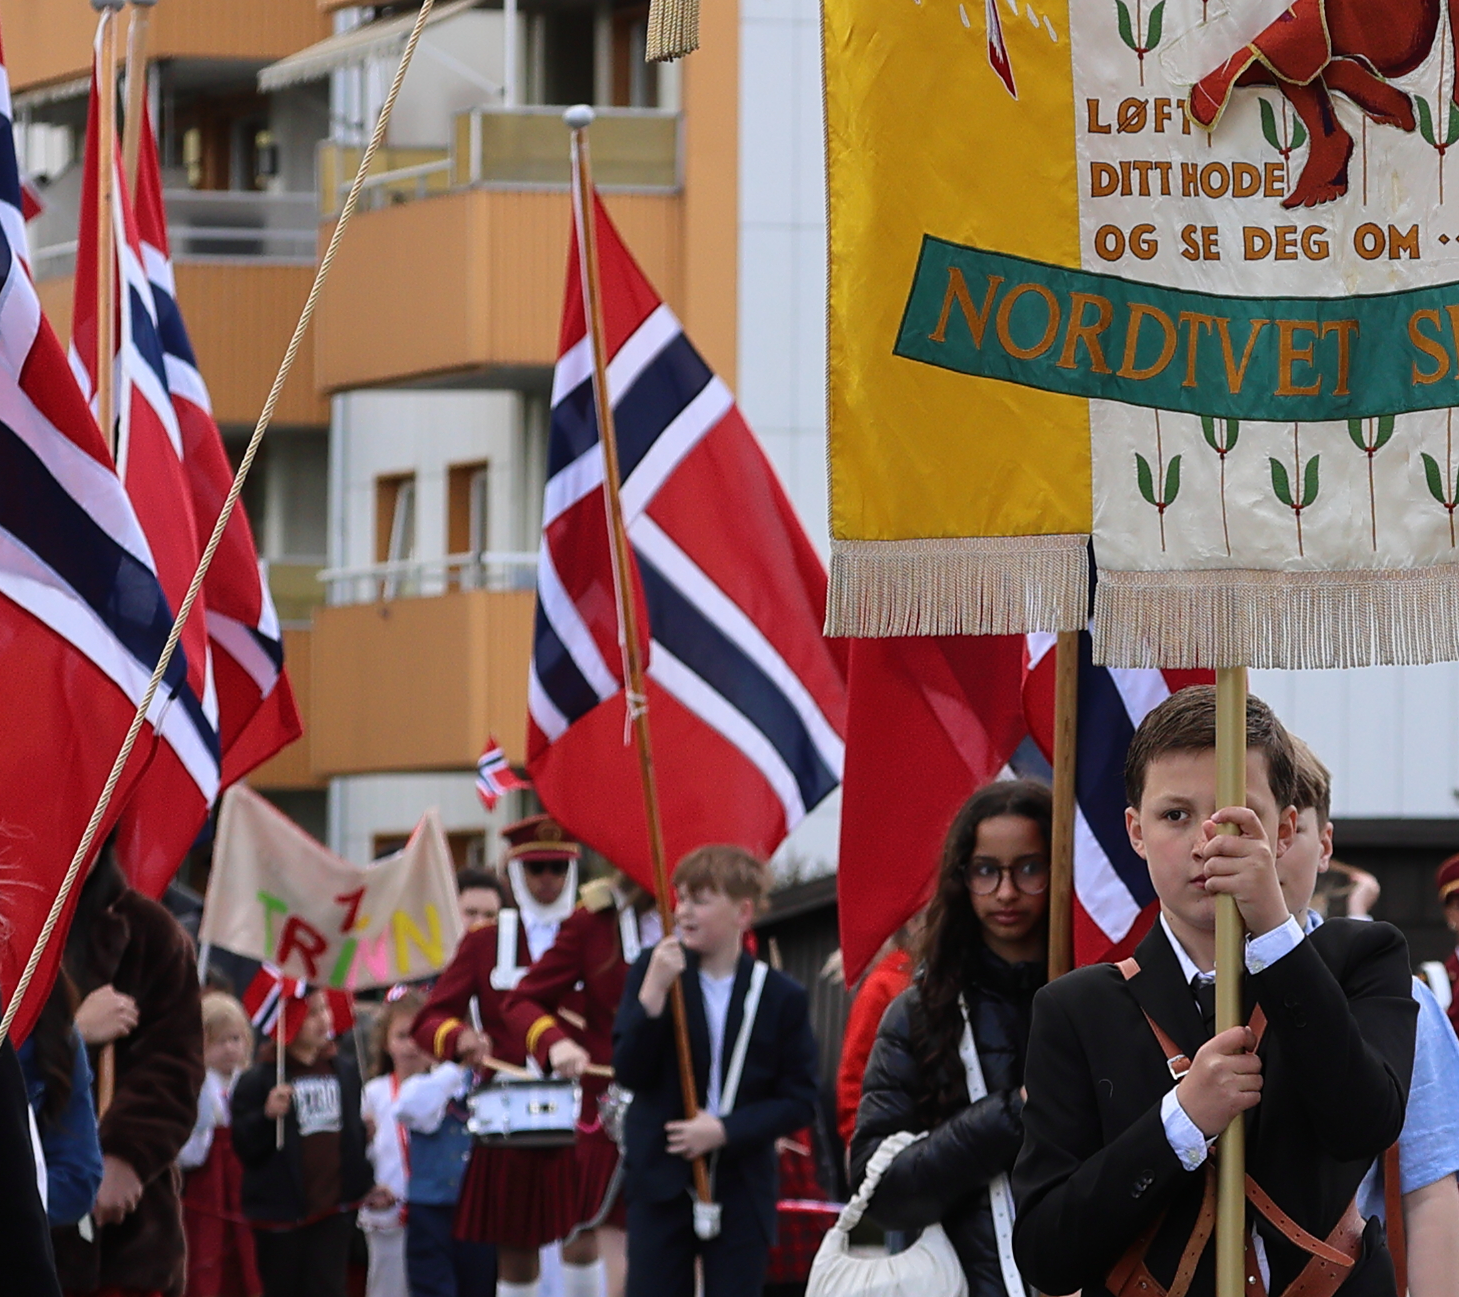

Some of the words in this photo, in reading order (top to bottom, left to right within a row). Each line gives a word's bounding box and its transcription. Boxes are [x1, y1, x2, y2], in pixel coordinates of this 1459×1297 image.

[1090, 161, 1172, 198] DITT
[1181, 161, 1285, 199] HODE
[1094, 223, 1158, 262] OG
[1181, 224, 1220, 261] SE
[1243, 224, 1330, 261] DEG
[928, 266, 1359, 397] NORDTVET
[256, 889, 444, 989] TRINN
